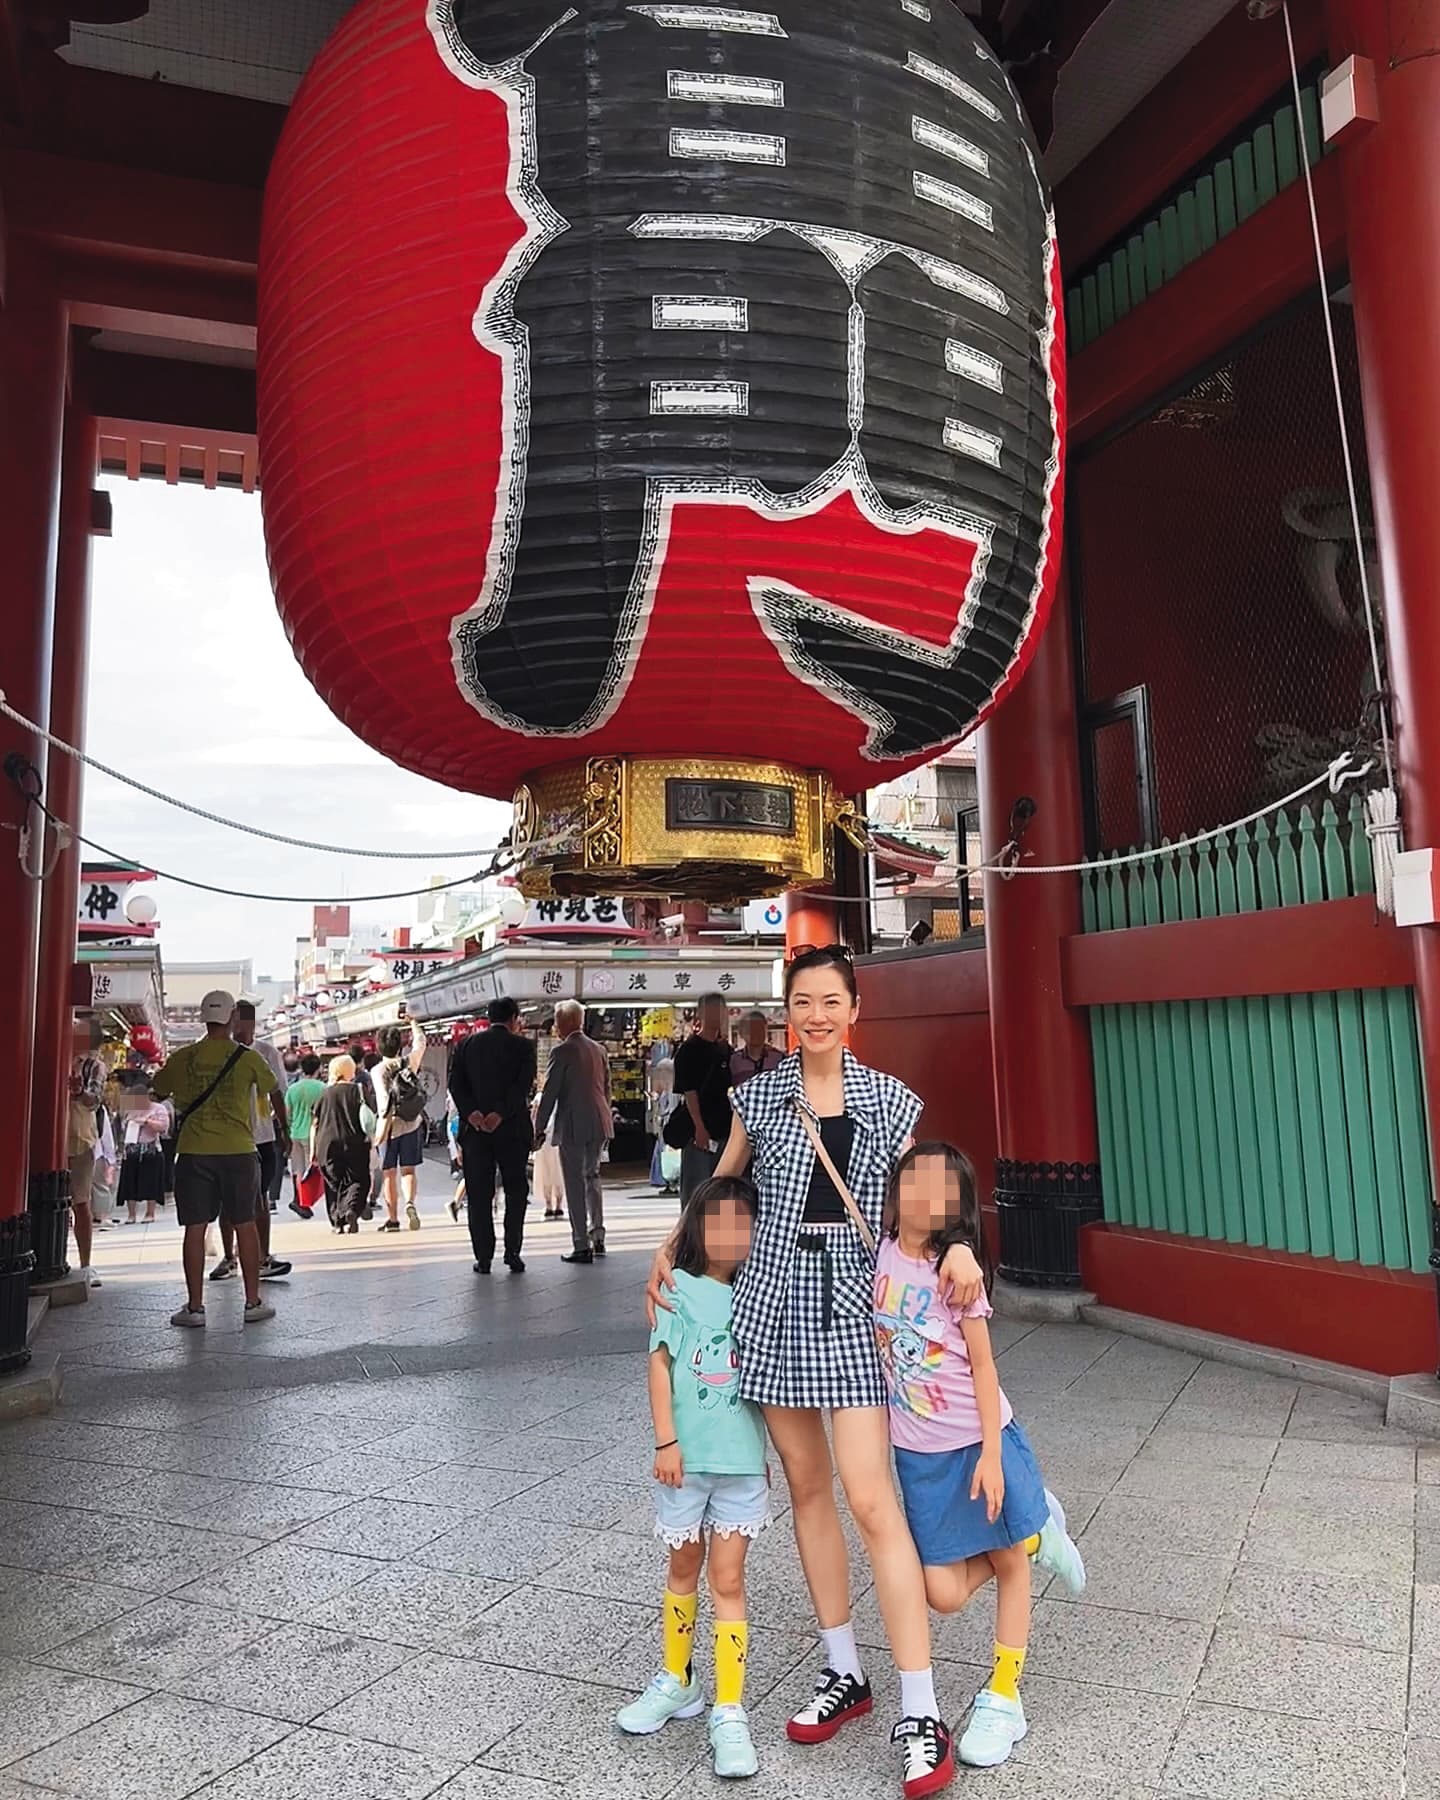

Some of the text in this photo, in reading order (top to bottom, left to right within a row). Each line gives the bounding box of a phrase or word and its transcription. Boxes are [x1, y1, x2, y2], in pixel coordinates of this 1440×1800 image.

[80, 884, 118, 920] 仲
[537, 896, 617, 922] 仲見世
